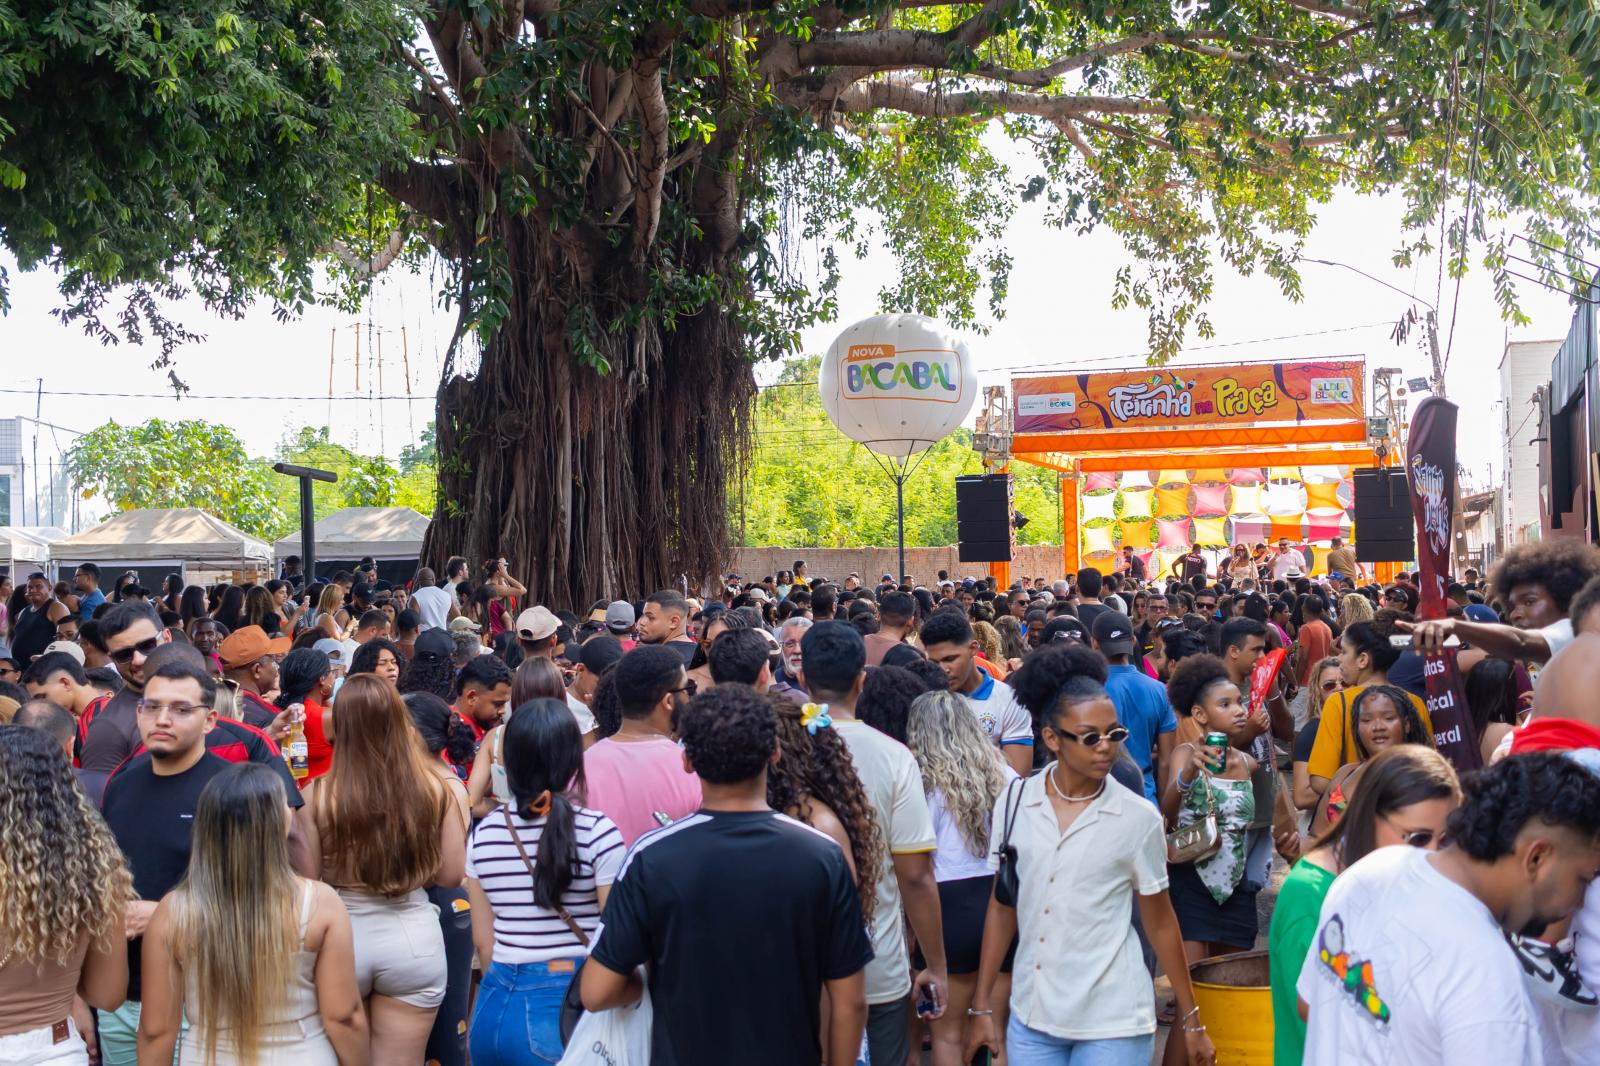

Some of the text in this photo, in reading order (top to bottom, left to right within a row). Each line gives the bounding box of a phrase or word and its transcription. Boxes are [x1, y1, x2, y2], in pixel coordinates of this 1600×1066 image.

[852, 347, 885, 357] NOVA
[847, 361, 957, 392] BACABAL
[1108, 383, 1192, 422] Feirinha
[1212, 377, 1278, 417] Praça
